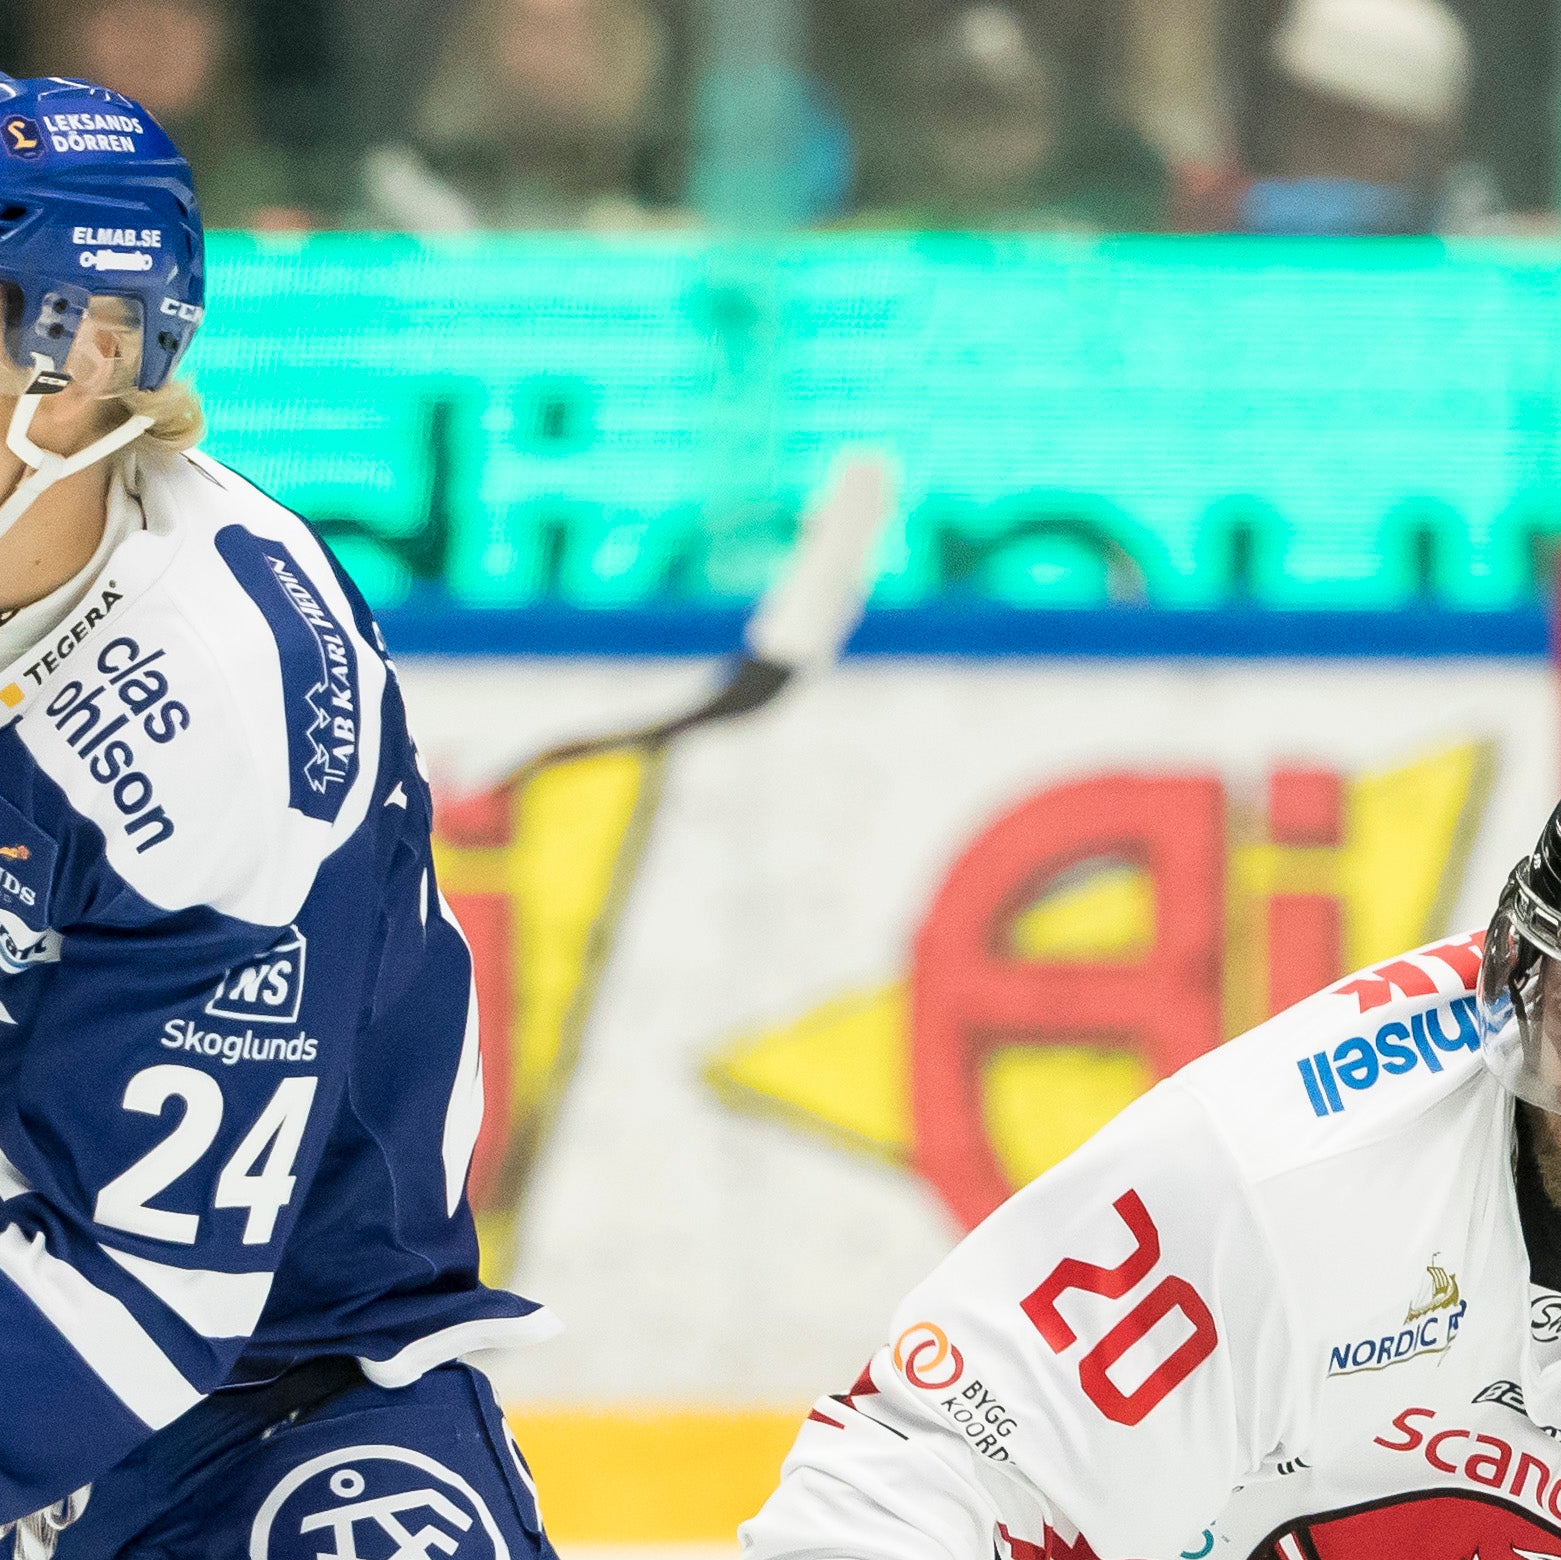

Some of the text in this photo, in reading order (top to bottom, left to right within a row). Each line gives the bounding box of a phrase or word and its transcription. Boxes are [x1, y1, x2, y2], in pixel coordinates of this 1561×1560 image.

[43, 114, 143, 136] LEKSANDS
[53, 131, 136, 153] DÖRREN
[72, 226, 162, 249] ELMAB.SE
[96, 636, 190, 745] clas
[46, 680, 176, 854] ohlson
[160, 1018, 319, 1066] Skoglunds
[92, 1063, 319, 1246] 24
[1019, 1187, 1219, 1427] 20
[1328, 1314, 1439, 1374] NORDIC
[941, 1396, 1020, 1465] KOORD
[961, 1379, 1019, 1440] BYGG
